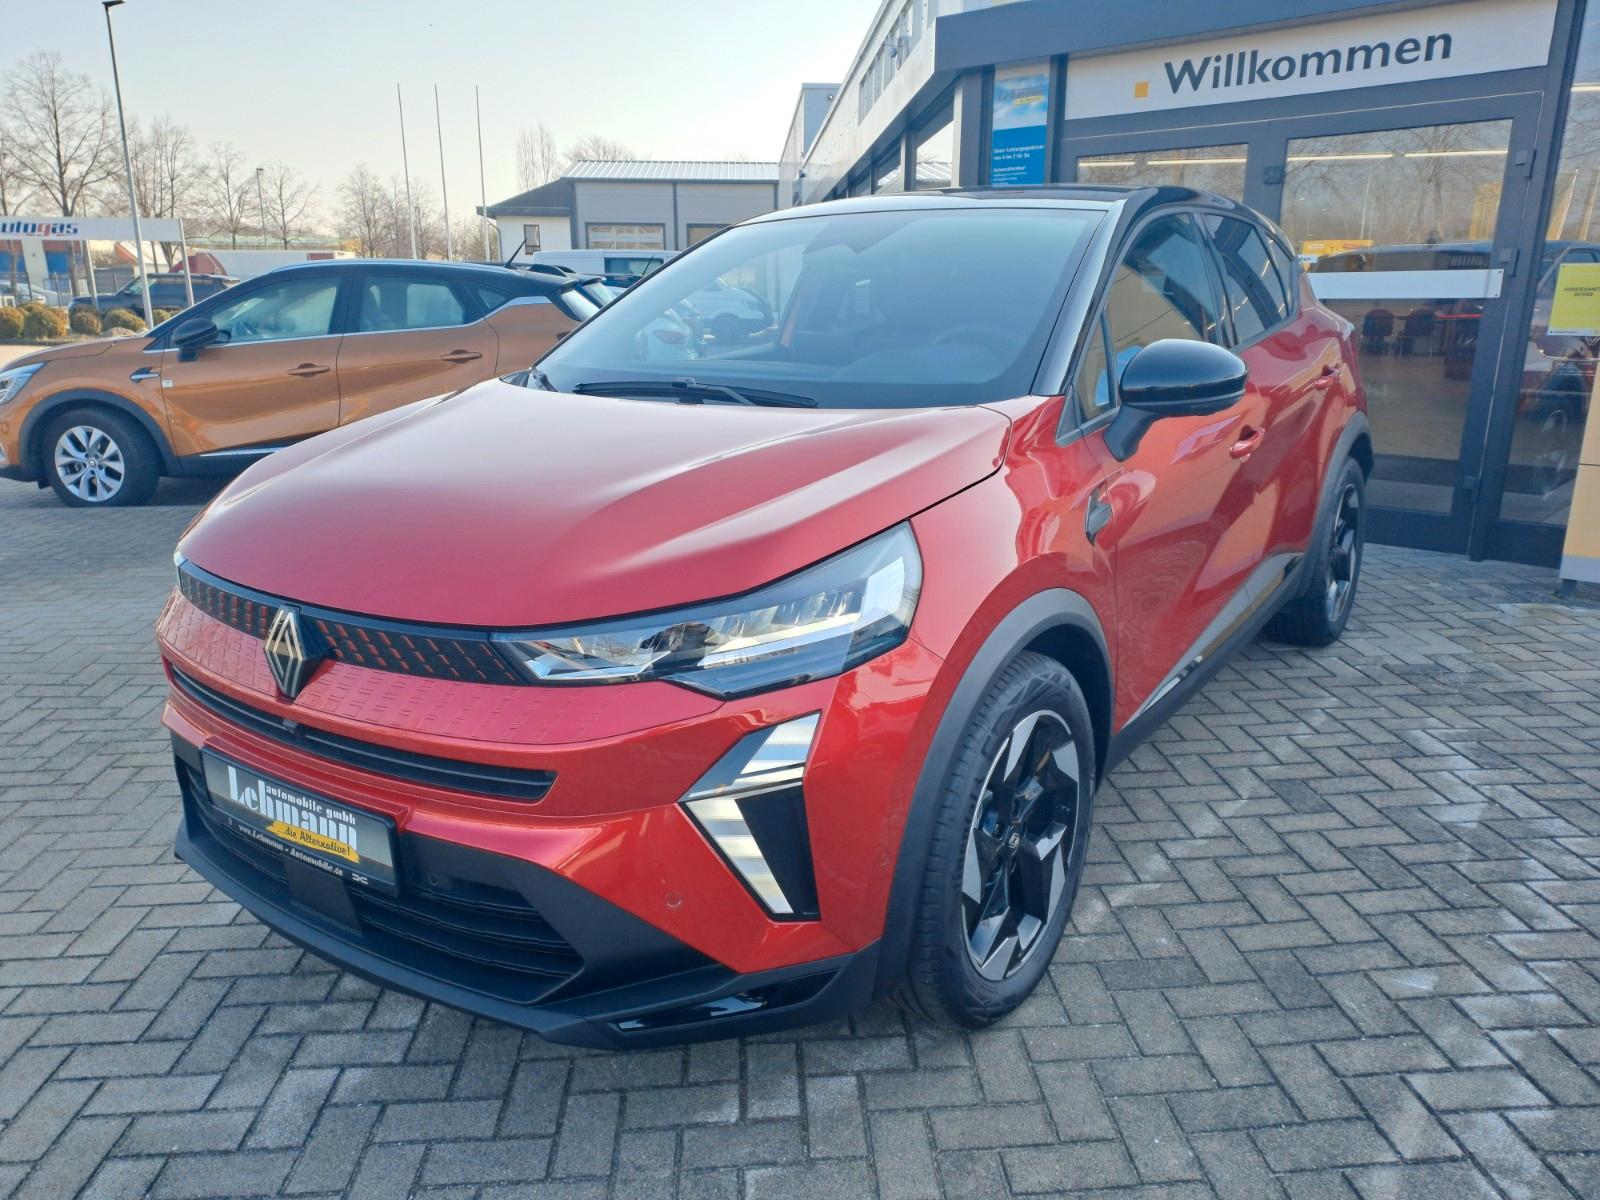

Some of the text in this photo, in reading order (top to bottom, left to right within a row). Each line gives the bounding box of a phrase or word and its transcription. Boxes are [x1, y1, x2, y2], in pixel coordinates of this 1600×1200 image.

[1164, 32, 1453, 94] Willkommen
[1, 221, 78, 236] utogas
[228, 764, 357, 850] Lehmann
[266, 784, 356, 825] automobile gmbh
